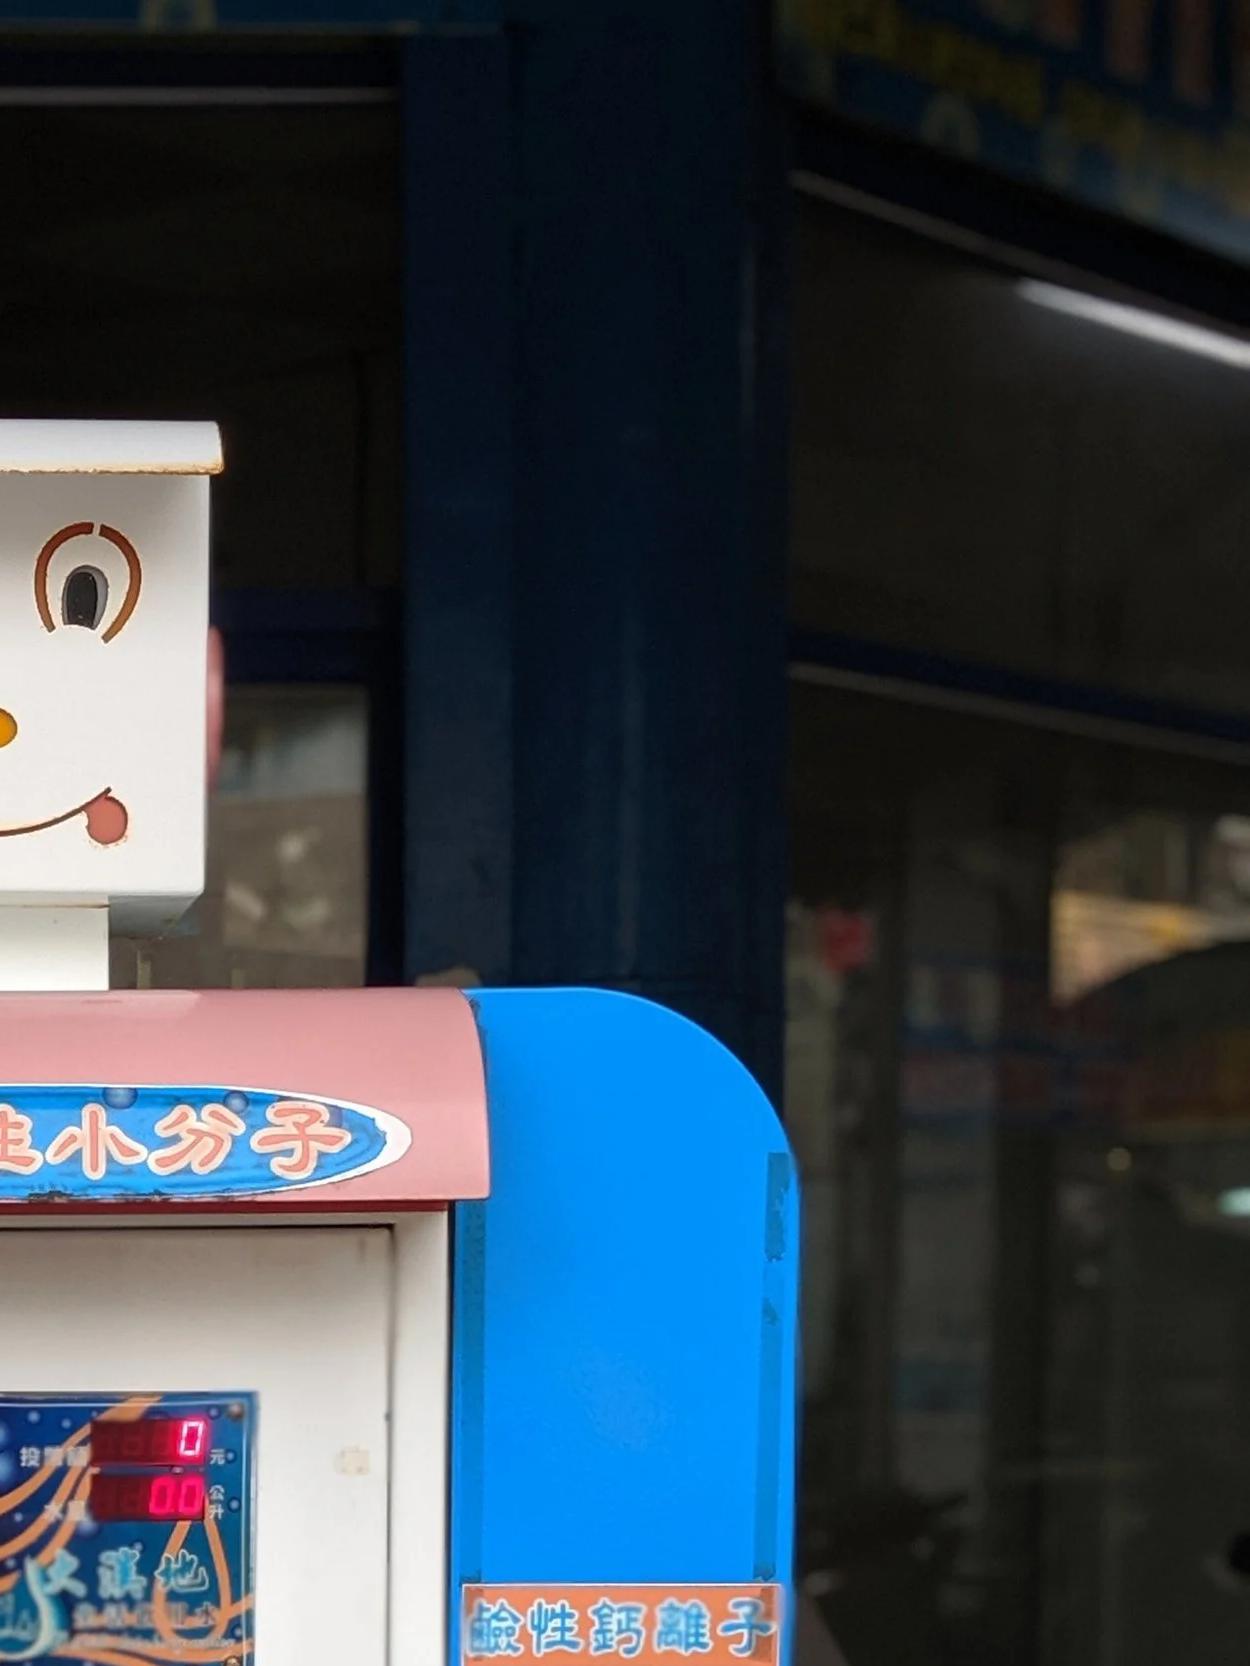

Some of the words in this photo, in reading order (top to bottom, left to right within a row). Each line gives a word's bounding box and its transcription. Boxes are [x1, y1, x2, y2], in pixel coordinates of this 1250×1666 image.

[179, 1420, 205, 1458] 0
[209, 1447, 226, 1465] 元
[464, 1595, 778, 1658] 鹼性鈣離子
